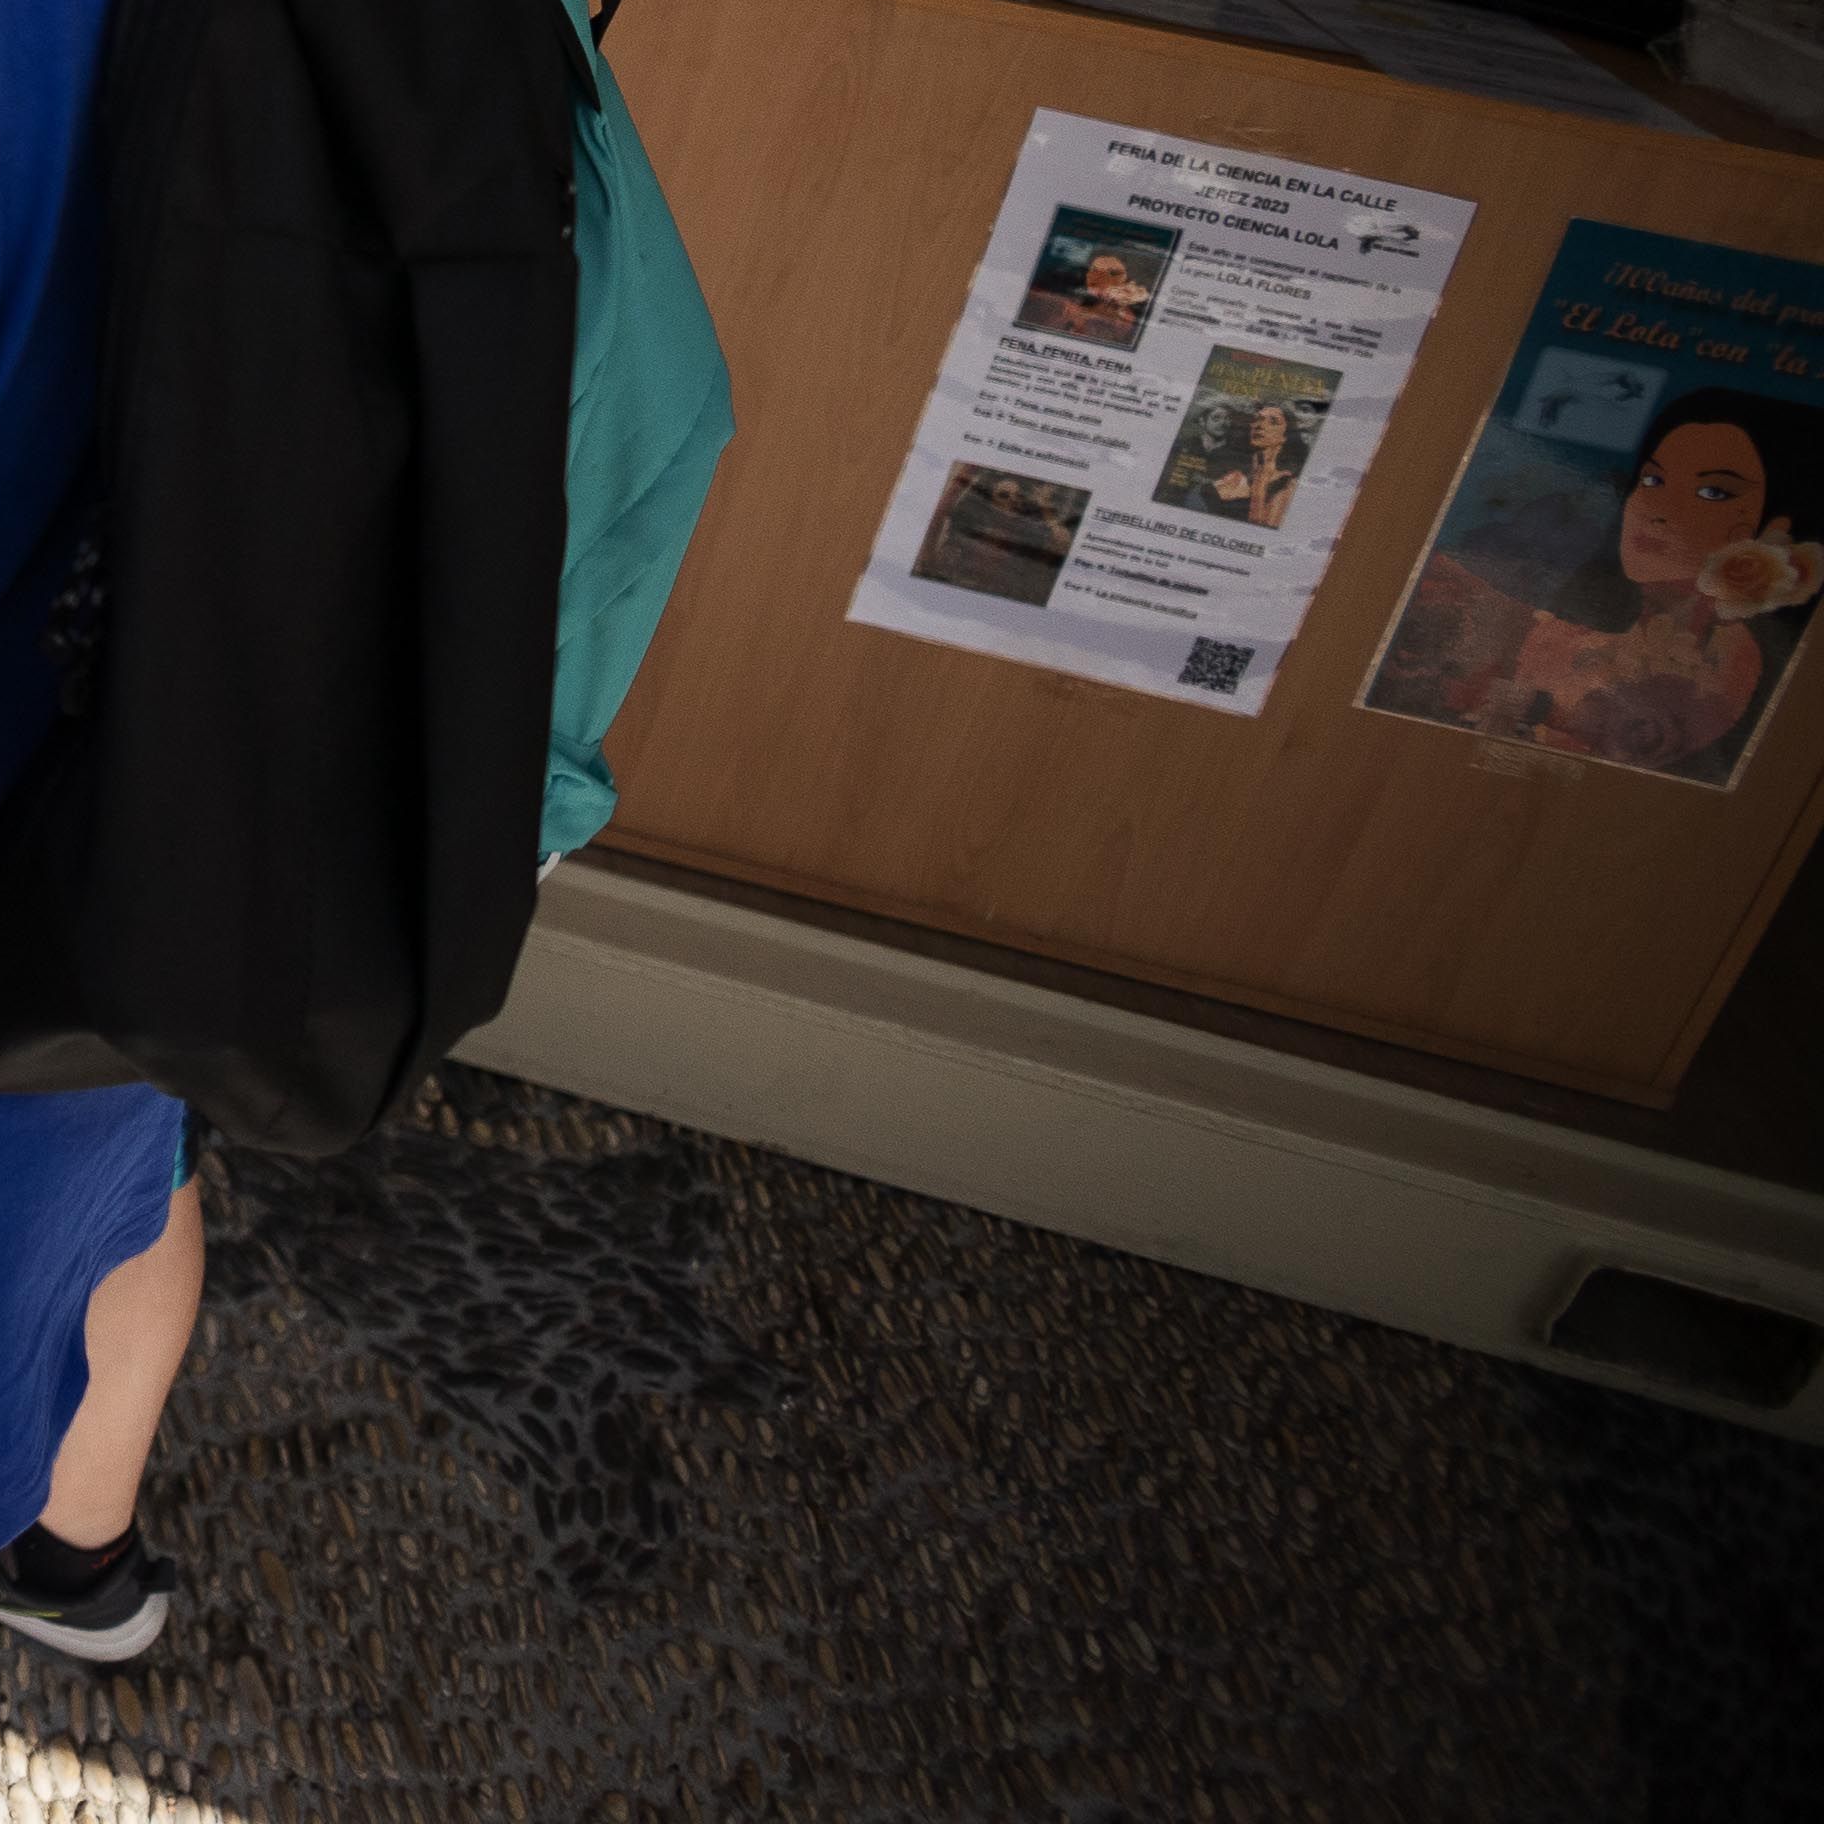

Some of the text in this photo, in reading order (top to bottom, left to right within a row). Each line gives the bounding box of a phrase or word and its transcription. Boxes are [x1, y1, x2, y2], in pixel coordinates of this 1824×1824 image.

[1107, 139, 1398, 214] FERIA DE LA CIENCIA EN LA CALLE
[1250, 195, 1290, 215] 2023
[1126, 193, 1341, 252] PROYECTO CIENCIA LOLA
[1216, 270, 1255, 288] LOLA
[1255, 278, 1312, 300] FLORES
[1695, 338, 1750, 364] con
[1178, 526, 1200, 541] DE
